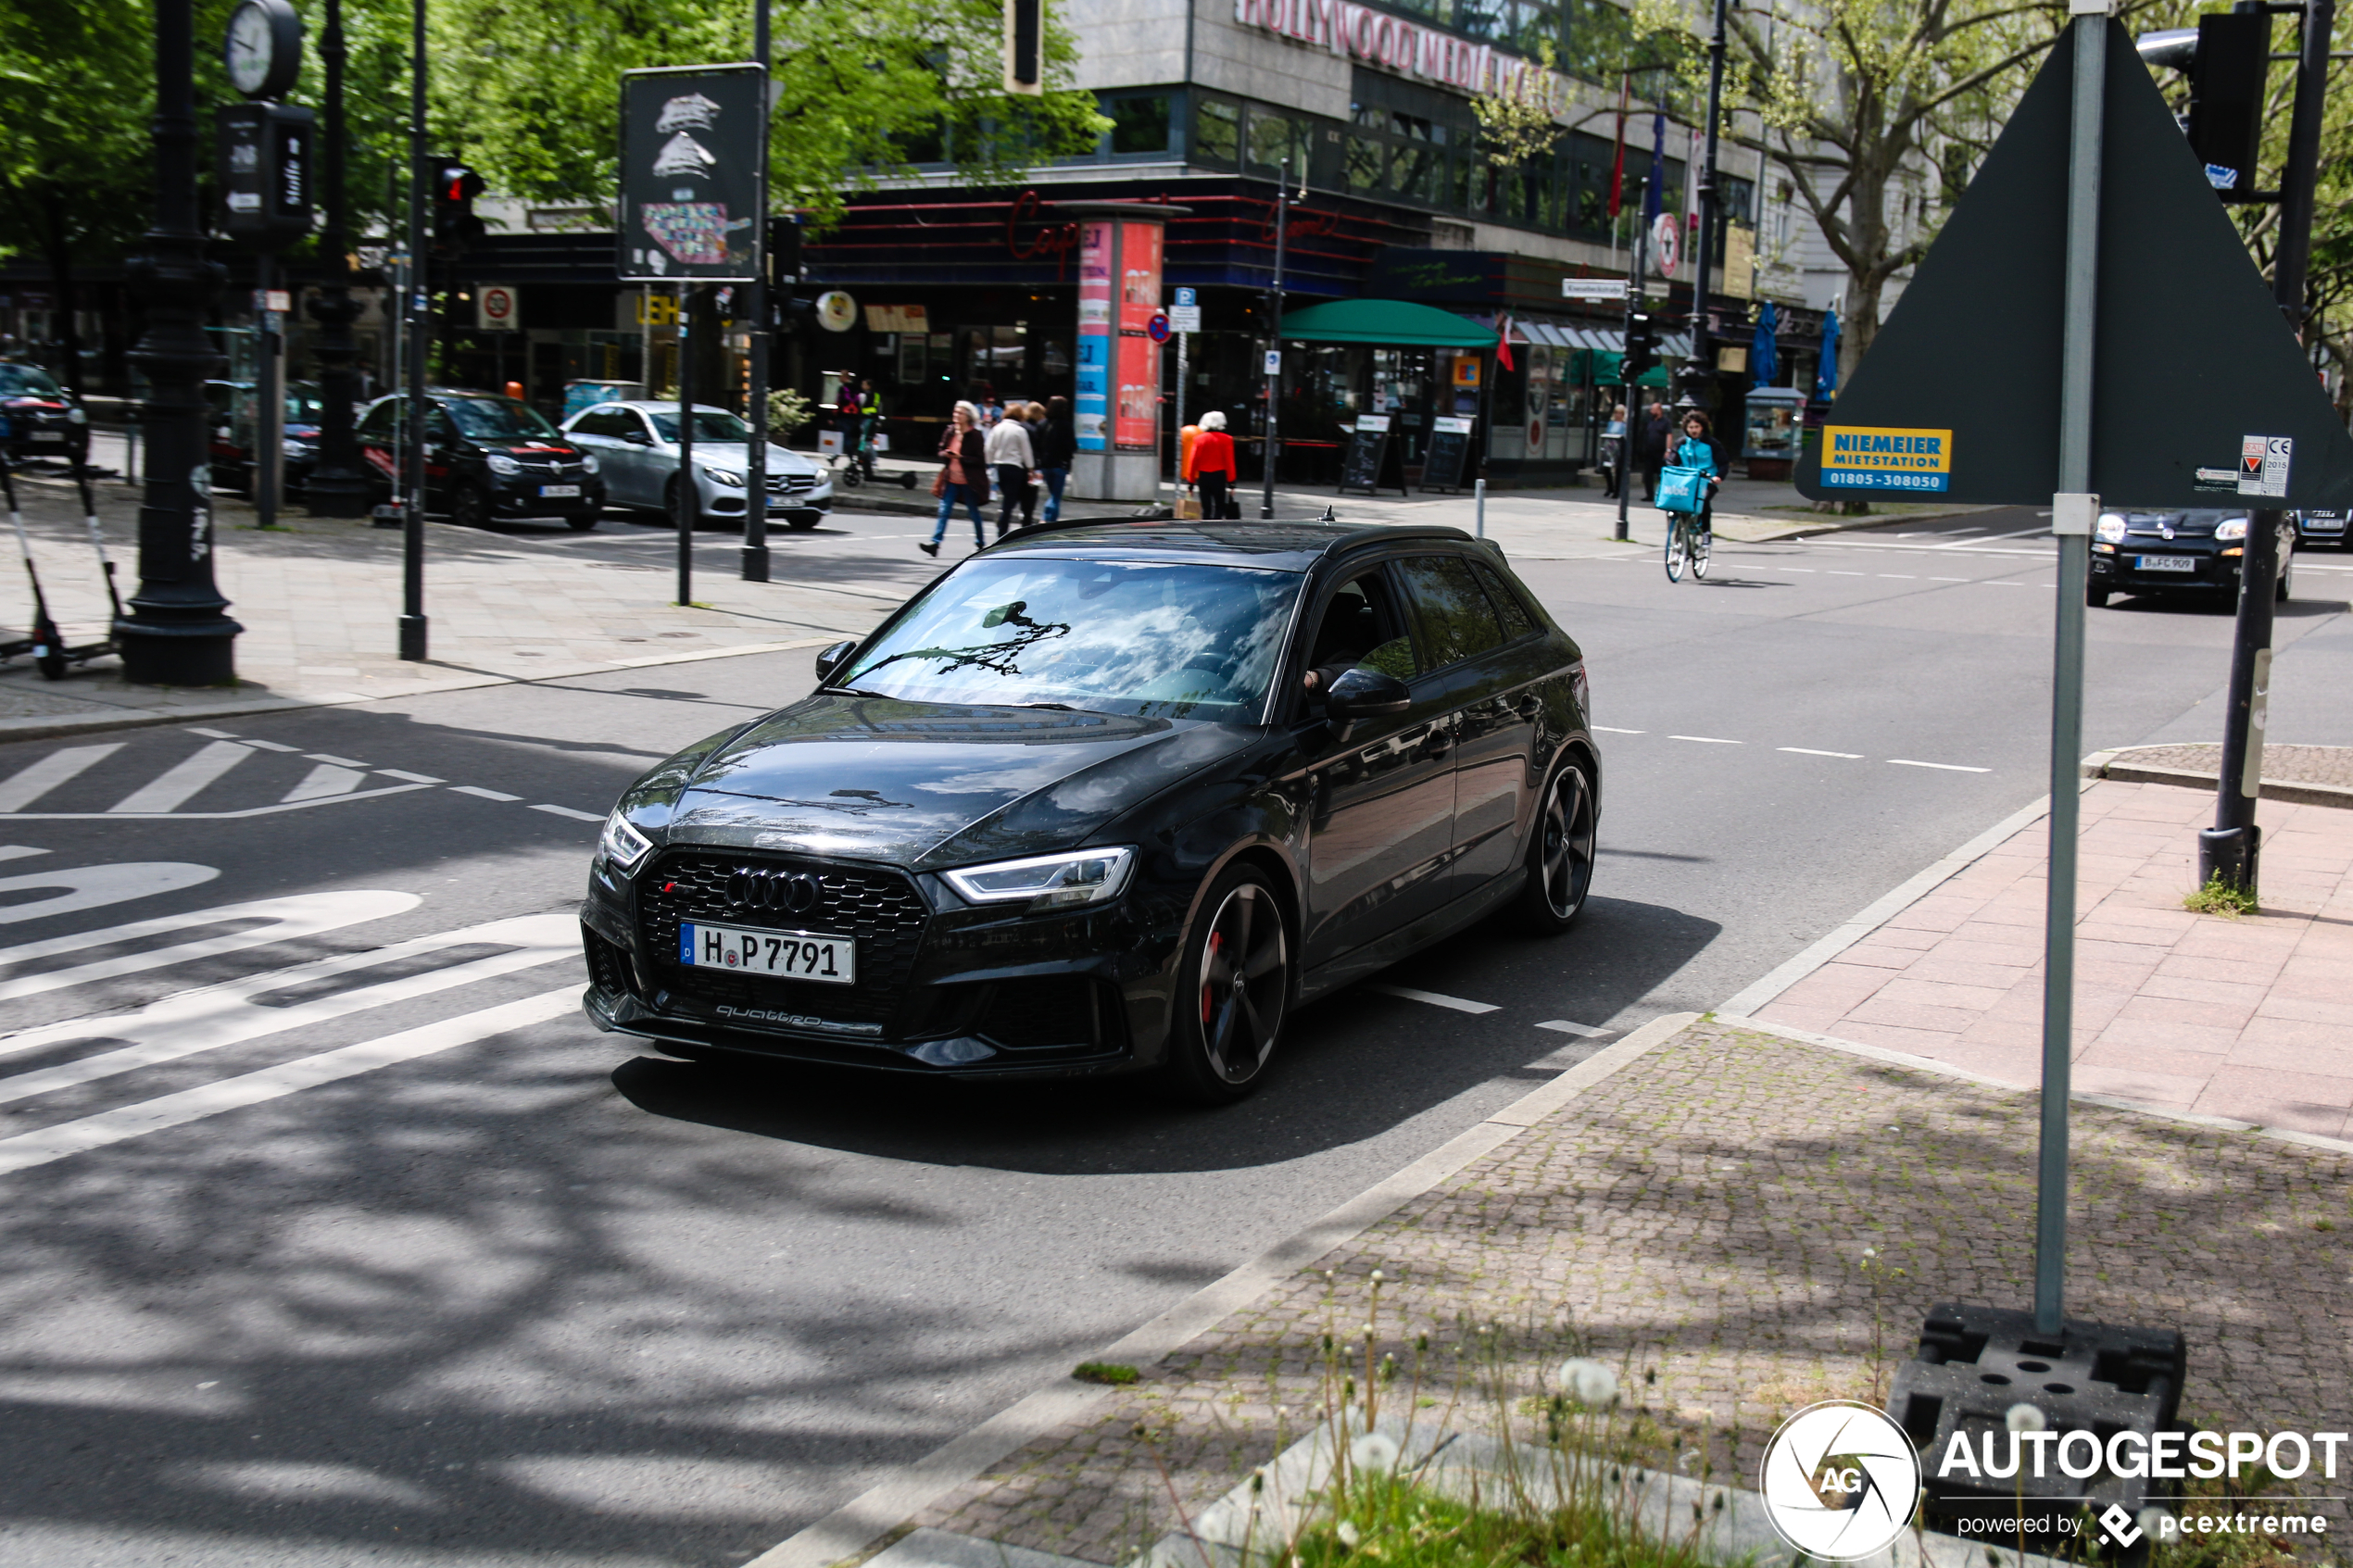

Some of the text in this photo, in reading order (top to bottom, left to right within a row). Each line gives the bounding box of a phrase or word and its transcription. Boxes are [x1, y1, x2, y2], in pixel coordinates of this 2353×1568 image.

[1834, 433, 1942, 455] NIEMEIER
[2245, 444, 2264, 453] RAL
[1833, 455, 1940, 468] MIETSTATION
[2267, 461, 2287, 470] 2015
[2145, 558, 2152, 568] B
[2172, 559, 2191, 570] 909
[705, 931, 838, 976] H P 7791
[716, 1004, 823, 1026] quattro
